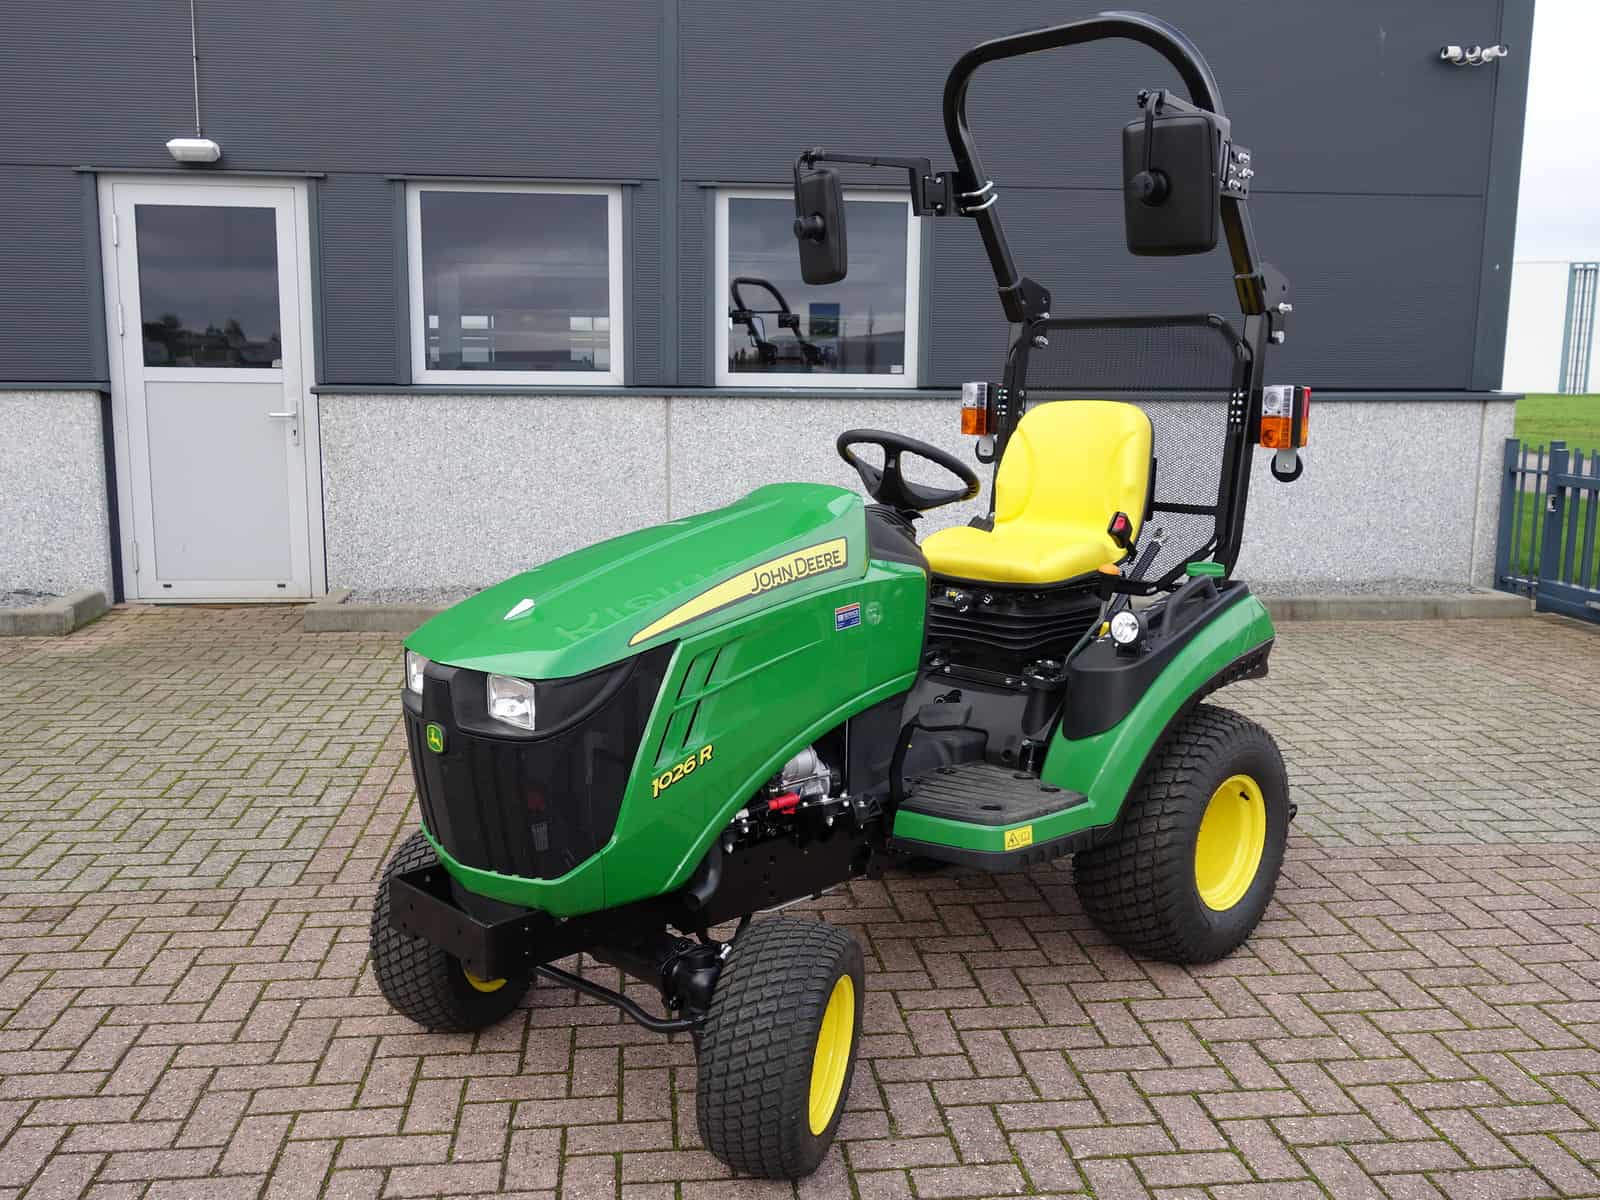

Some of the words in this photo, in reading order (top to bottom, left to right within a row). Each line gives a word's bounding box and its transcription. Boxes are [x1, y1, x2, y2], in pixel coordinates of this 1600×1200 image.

[752, 564, 793, 592] JOHN
[794, 550, 840, 575] DEERE
[651, 754, 698, 799] 1026
[699, 744, 714, 766] R
